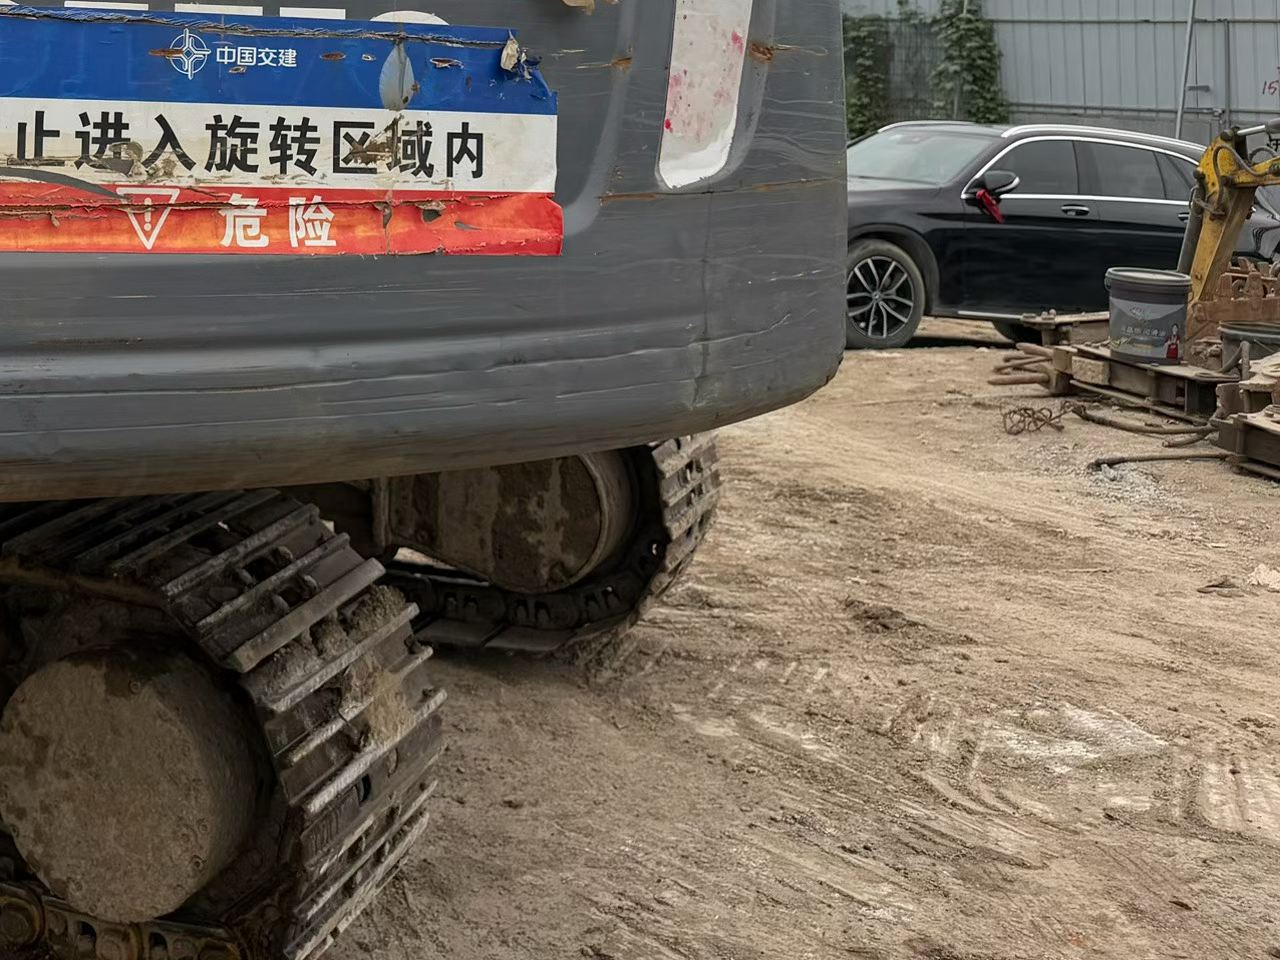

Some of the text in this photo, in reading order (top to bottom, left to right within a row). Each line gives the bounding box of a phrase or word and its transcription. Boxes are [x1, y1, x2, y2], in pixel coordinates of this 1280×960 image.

[215, 45, 297, 69] 中国交建
[220, 194, 337, 247] 危险
